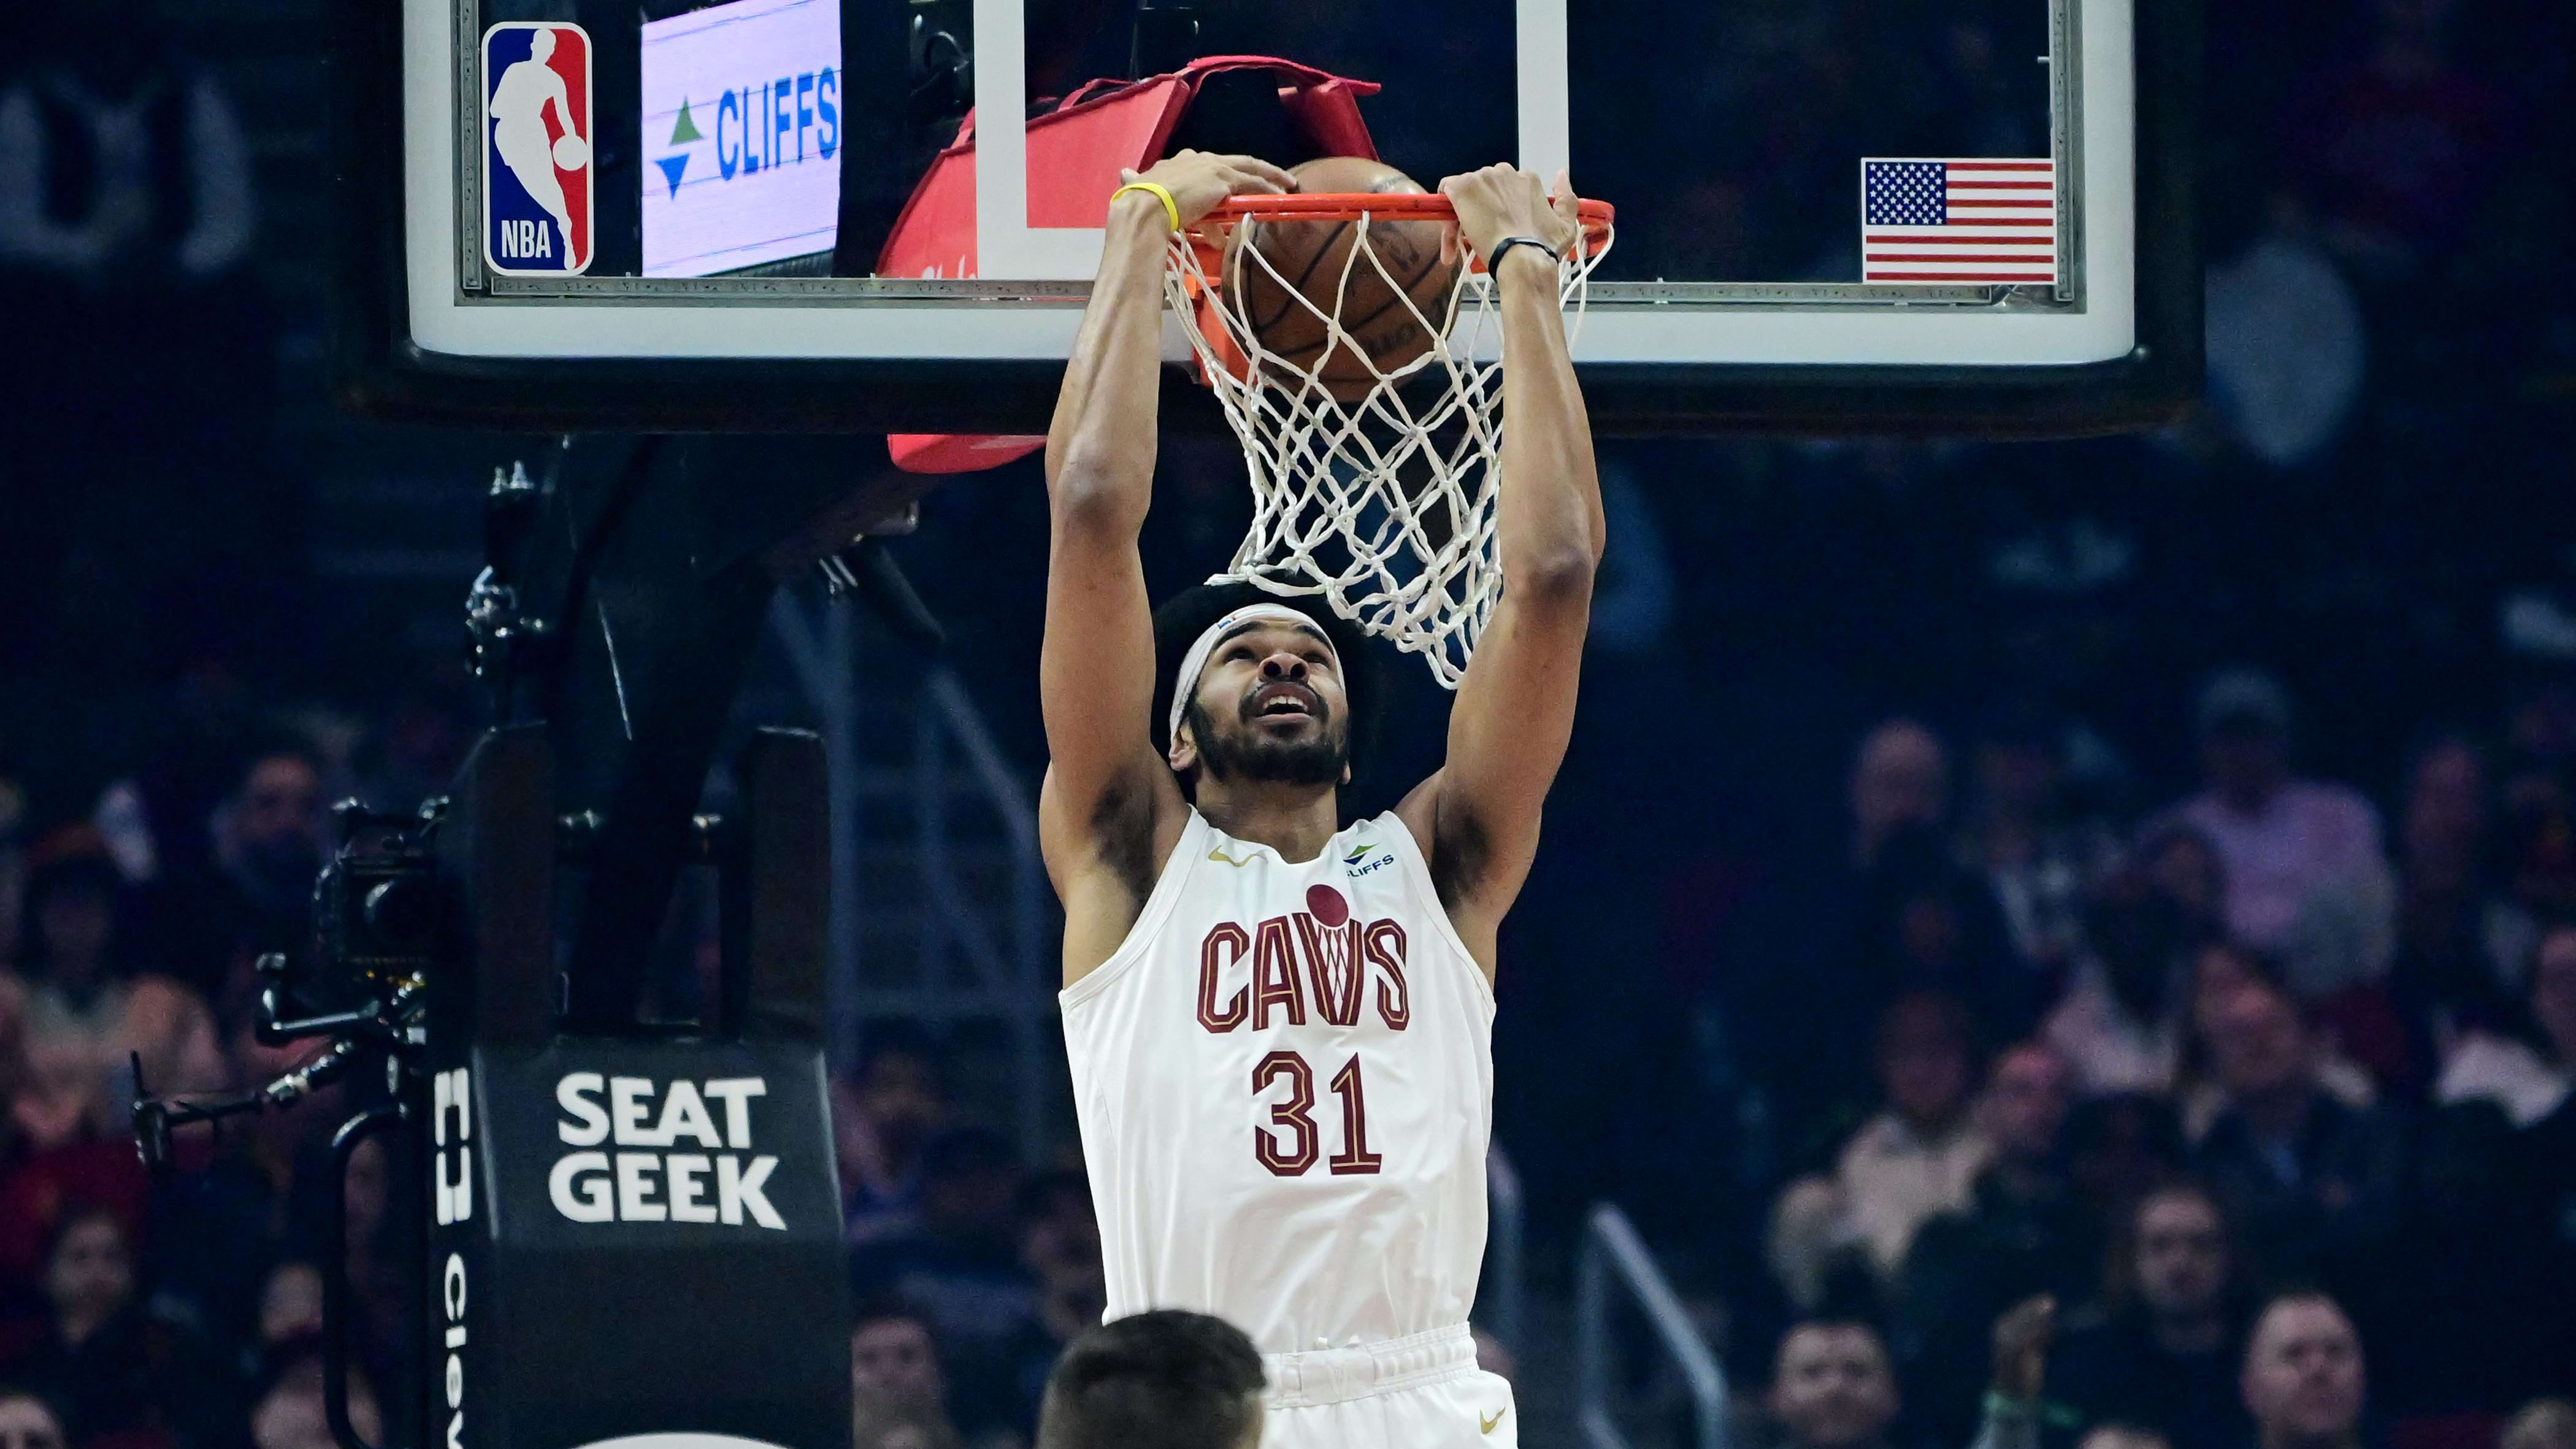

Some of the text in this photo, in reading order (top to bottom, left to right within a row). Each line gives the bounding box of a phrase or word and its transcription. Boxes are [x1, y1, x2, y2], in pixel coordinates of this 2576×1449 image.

[717, 66, 838, 182] CLIFFS
[502, 220, 552, 258] NBA
[1197, 912, 1409, 1034] CAVS
[556, 1071, 767, 1150] SEAT
[1252, 1050, 1382, 1177] 31
[548, 1151, 788, 1232] GEEK
